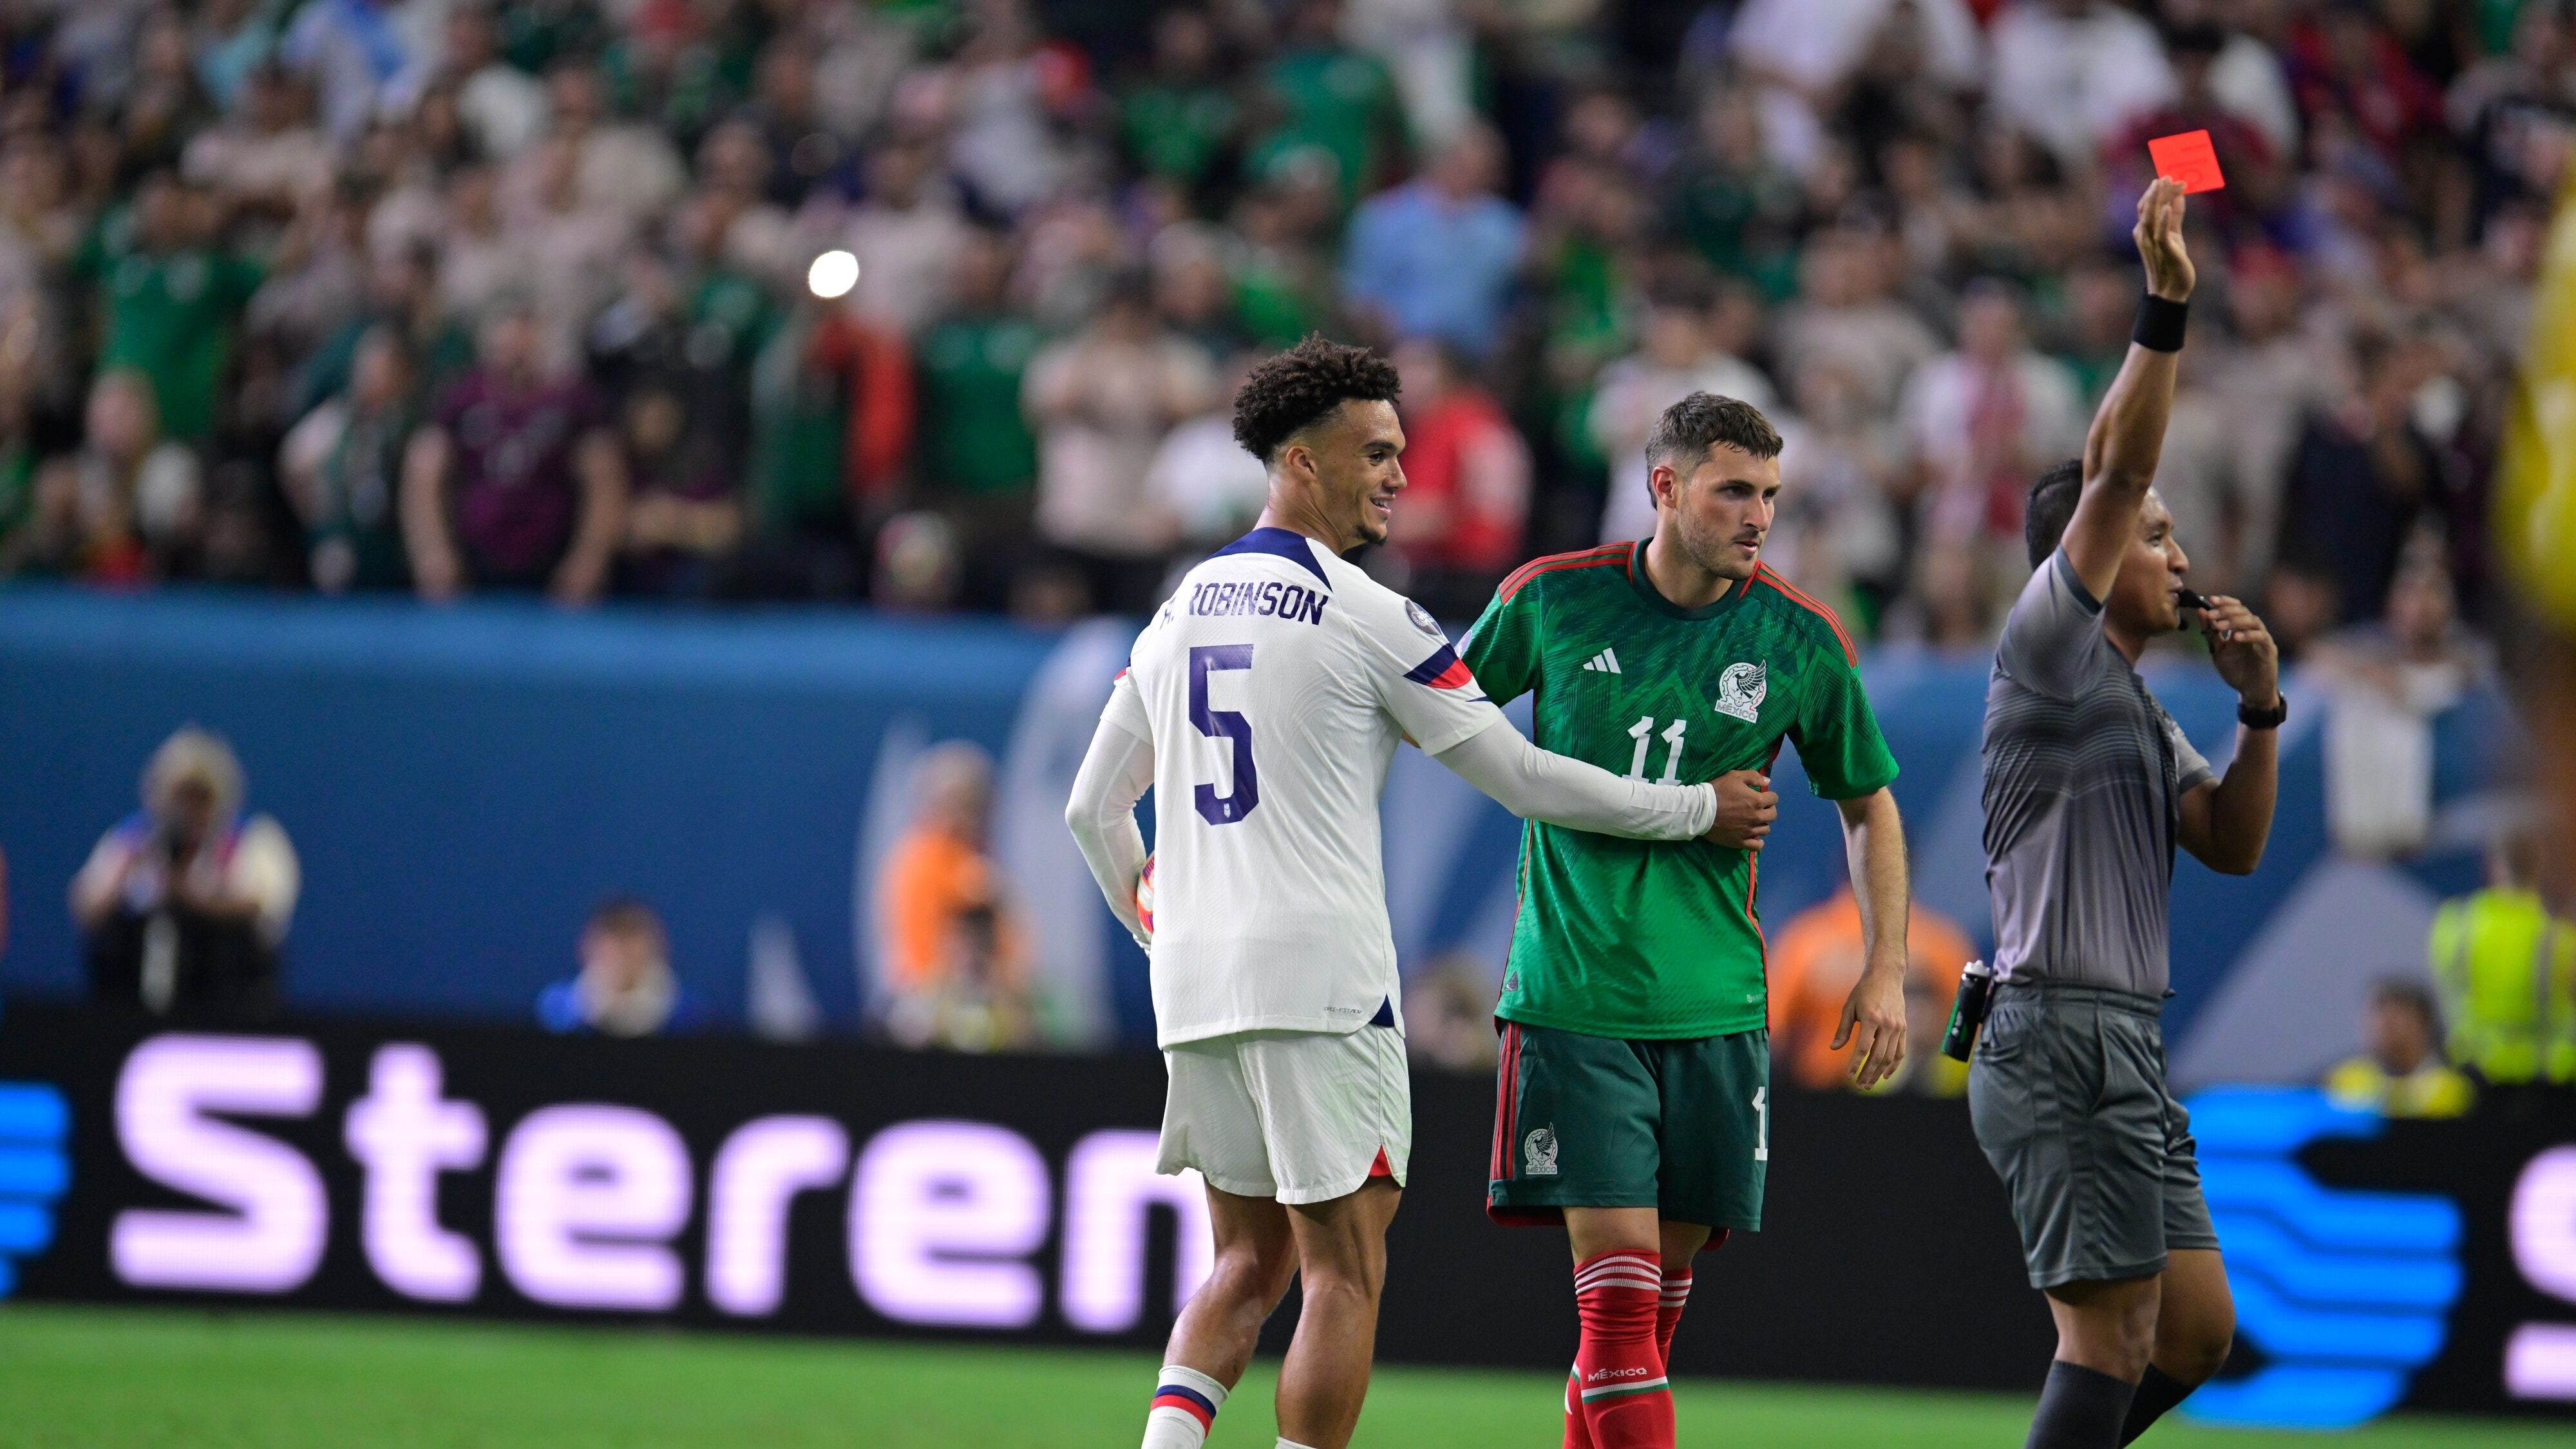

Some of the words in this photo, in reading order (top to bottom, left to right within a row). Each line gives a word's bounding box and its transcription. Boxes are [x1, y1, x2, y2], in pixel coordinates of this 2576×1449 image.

[1189, 644, 1260, 826] 5
[1622, 715, 1687, 786] 11
[108, 1032, 1216, 1333] Steren
